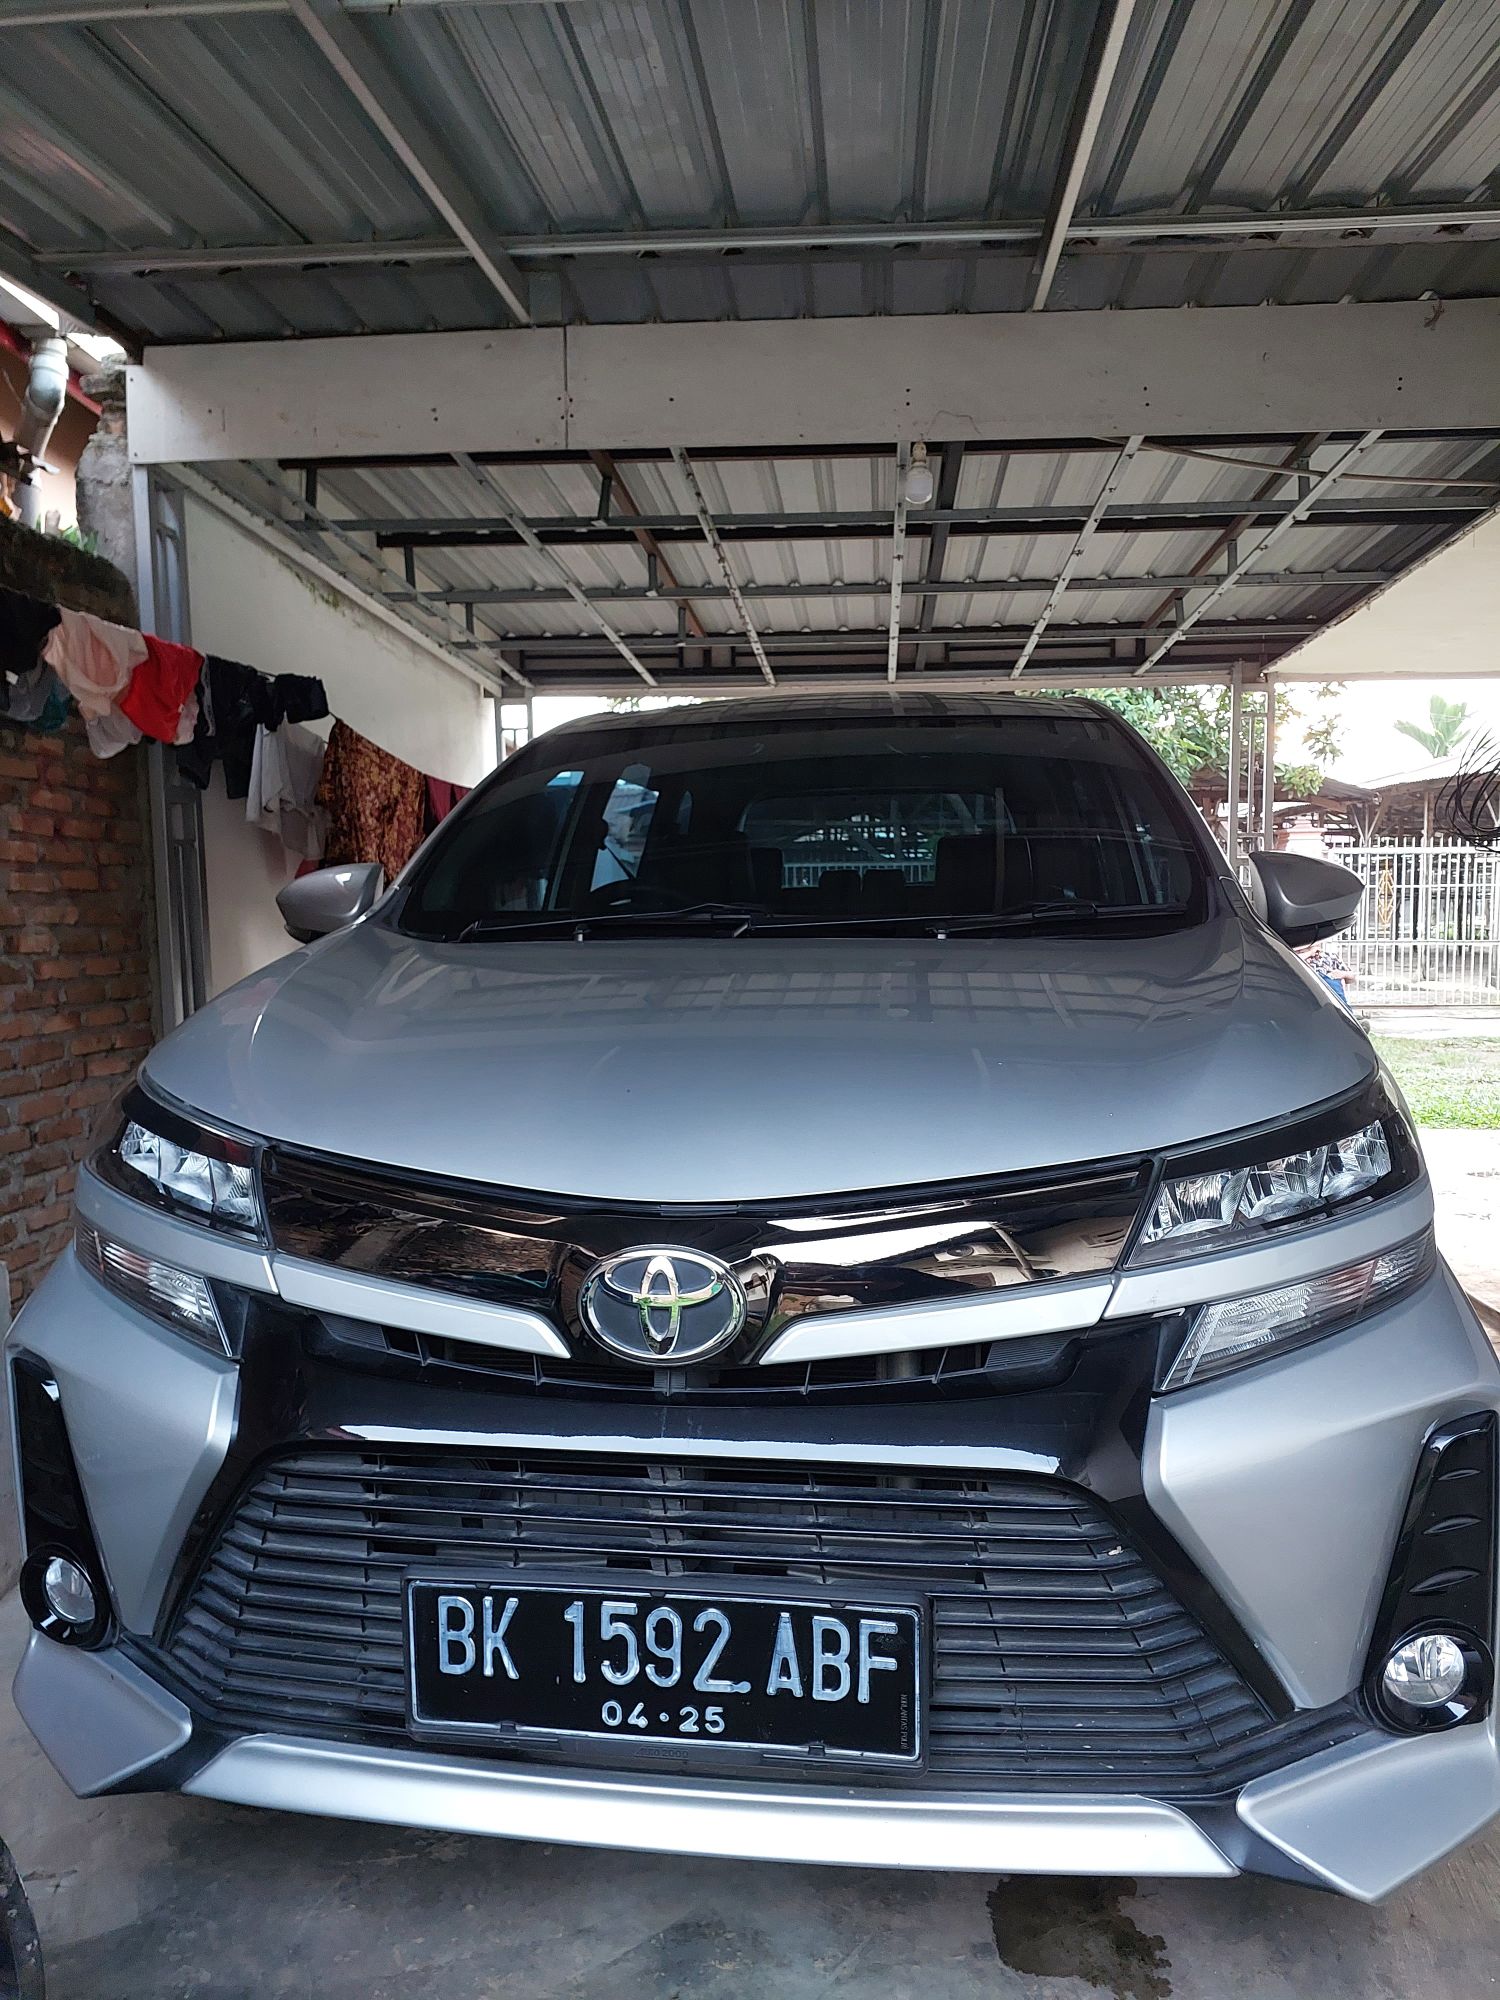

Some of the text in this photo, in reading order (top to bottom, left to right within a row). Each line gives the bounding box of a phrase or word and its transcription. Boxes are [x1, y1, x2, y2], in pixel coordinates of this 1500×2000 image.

[437, 1595, 899, 1704] BK 1592 ABF
